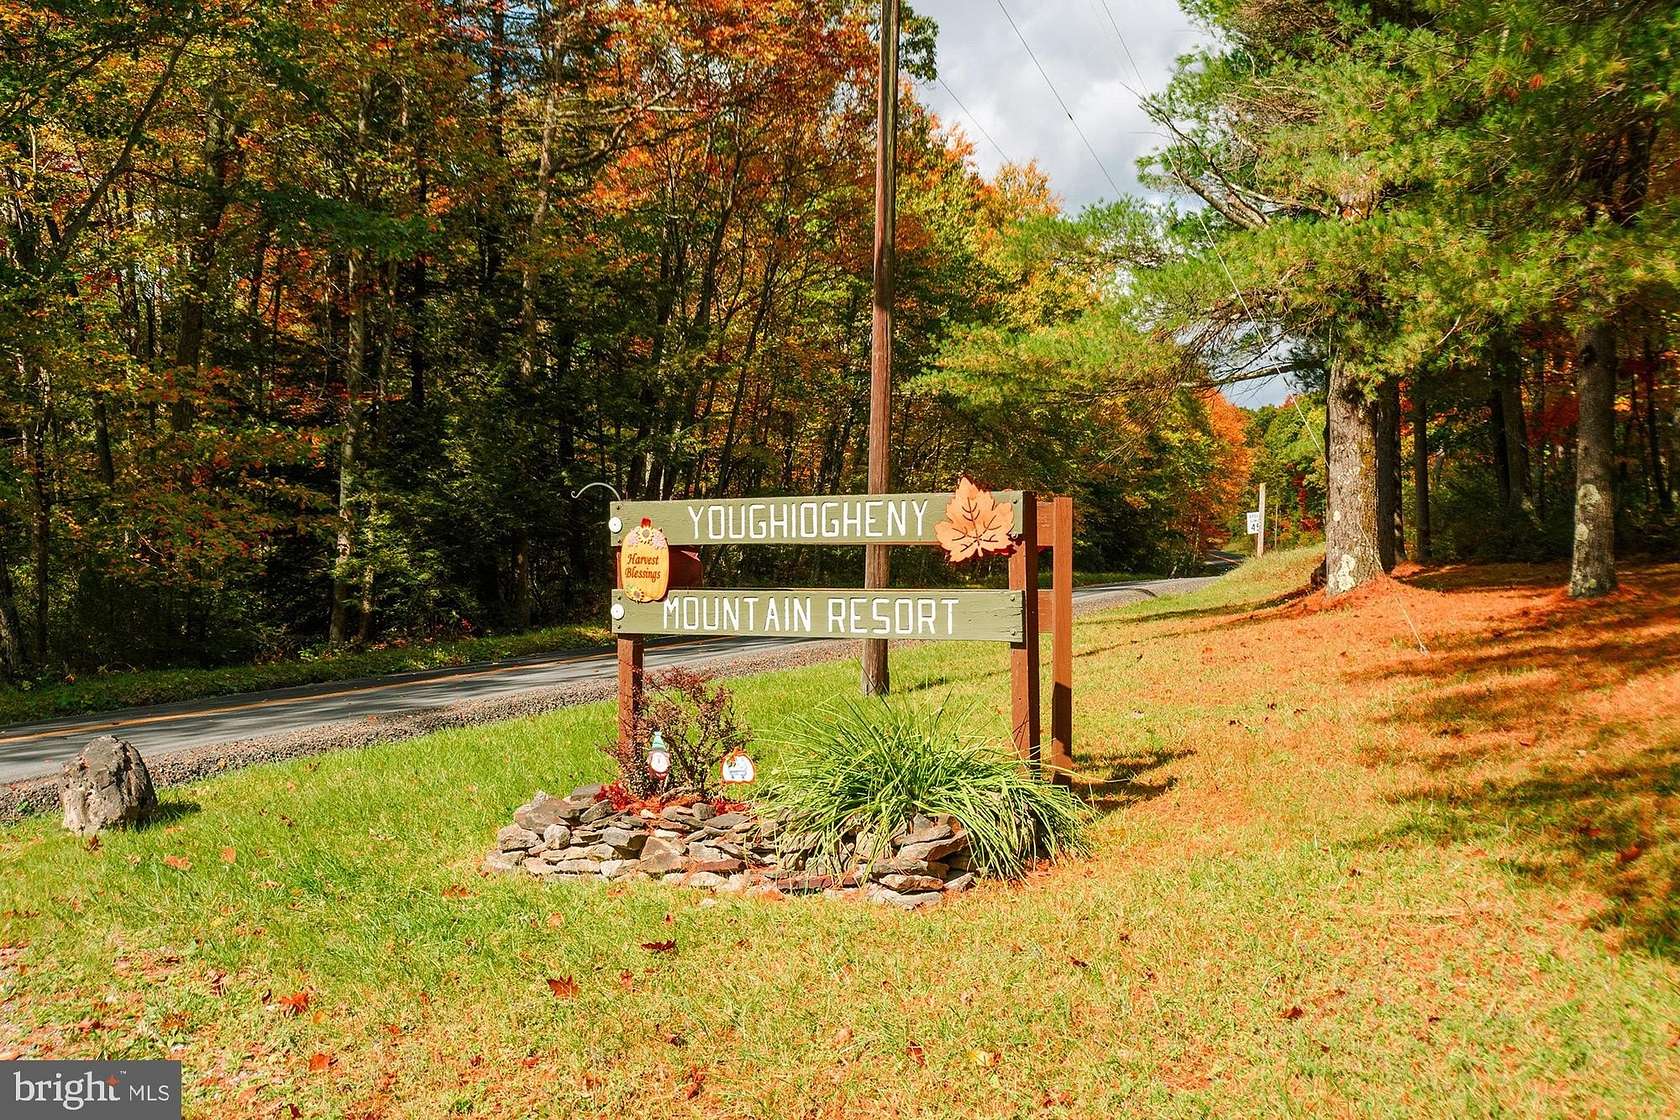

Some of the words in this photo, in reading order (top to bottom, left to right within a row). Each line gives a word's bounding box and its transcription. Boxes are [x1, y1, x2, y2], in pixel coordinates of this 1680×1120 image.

[687, 500, 929, 540] YOUGHIOGHENY
[626, 552, 660, 566] Harvest
[624, 566, 662, 583] Blessings
[663, 596, 812, 633] MOUNTAIN
[827, 597, 960, 635] RESORT
